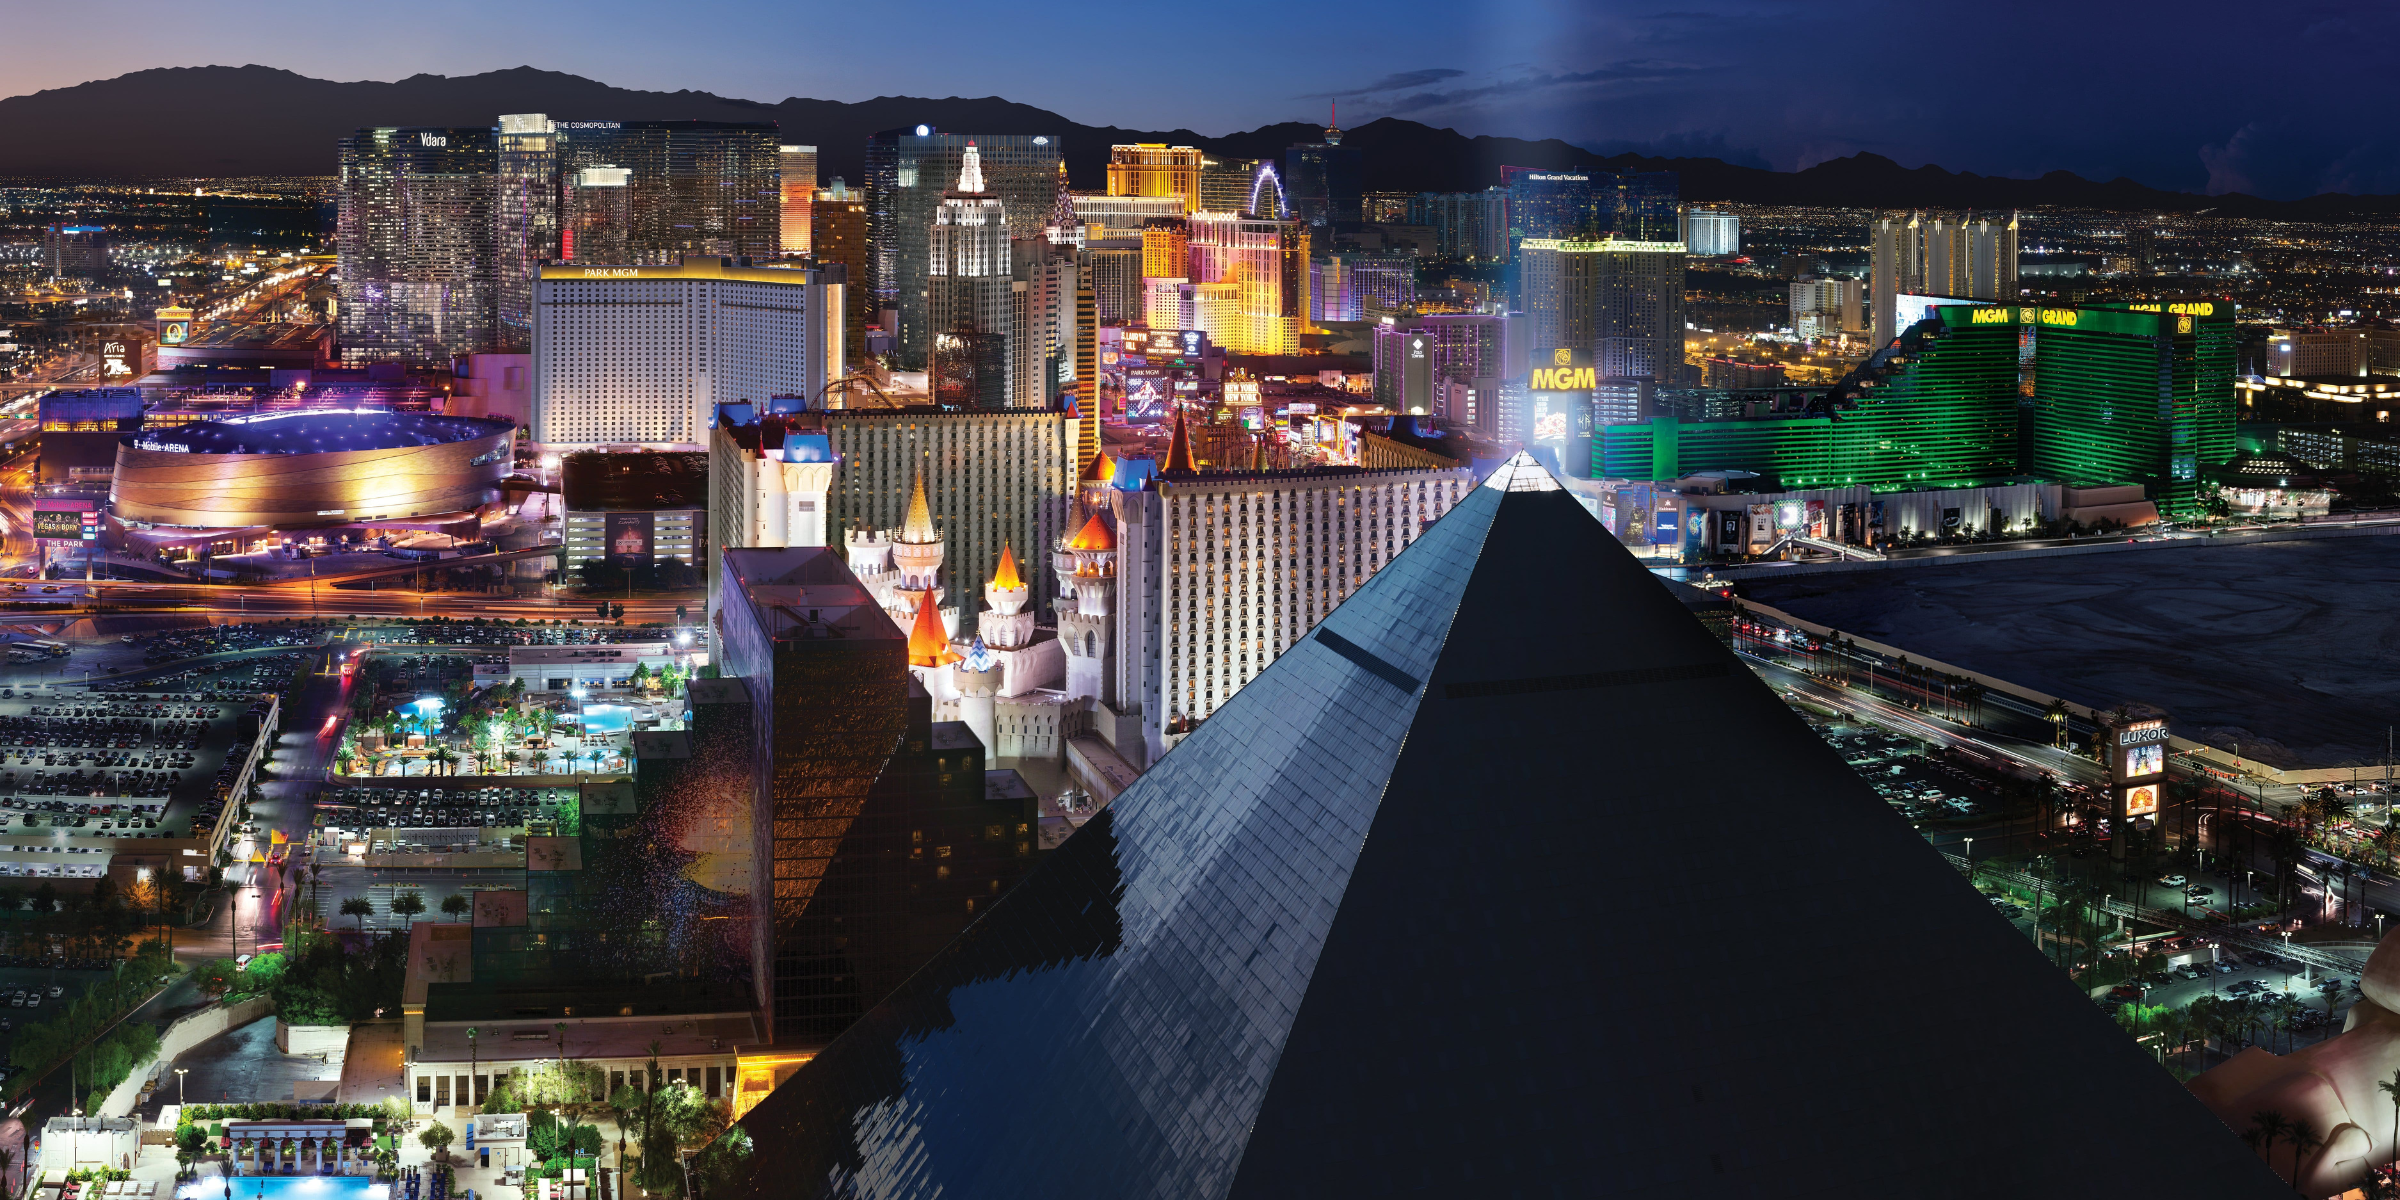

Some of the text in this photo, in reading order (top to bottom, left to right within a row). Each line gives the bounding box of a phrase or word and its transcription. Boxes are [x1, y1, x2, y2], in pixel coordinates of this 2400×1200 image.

[557, 121, 621, 129] THE COSMOPOLITAN
[420, 132, 446, 147] Vdara
[1192, 209, 1237, 224] hollywood
[584, 268, 638, 277] PARK MGM
[1972, 309, 2077, 326] MGM GRAND
[104, 342, 125, 354] Aria
[1532, 368, 1596, 390] MGM
[1225, 383, 1257, 392] NEW YORK
[1225, 393, 1257, 402] NEW YORK
[164, 443, 189, 453] ARENA
[2120, 727, 2169, 746] LUXOR
